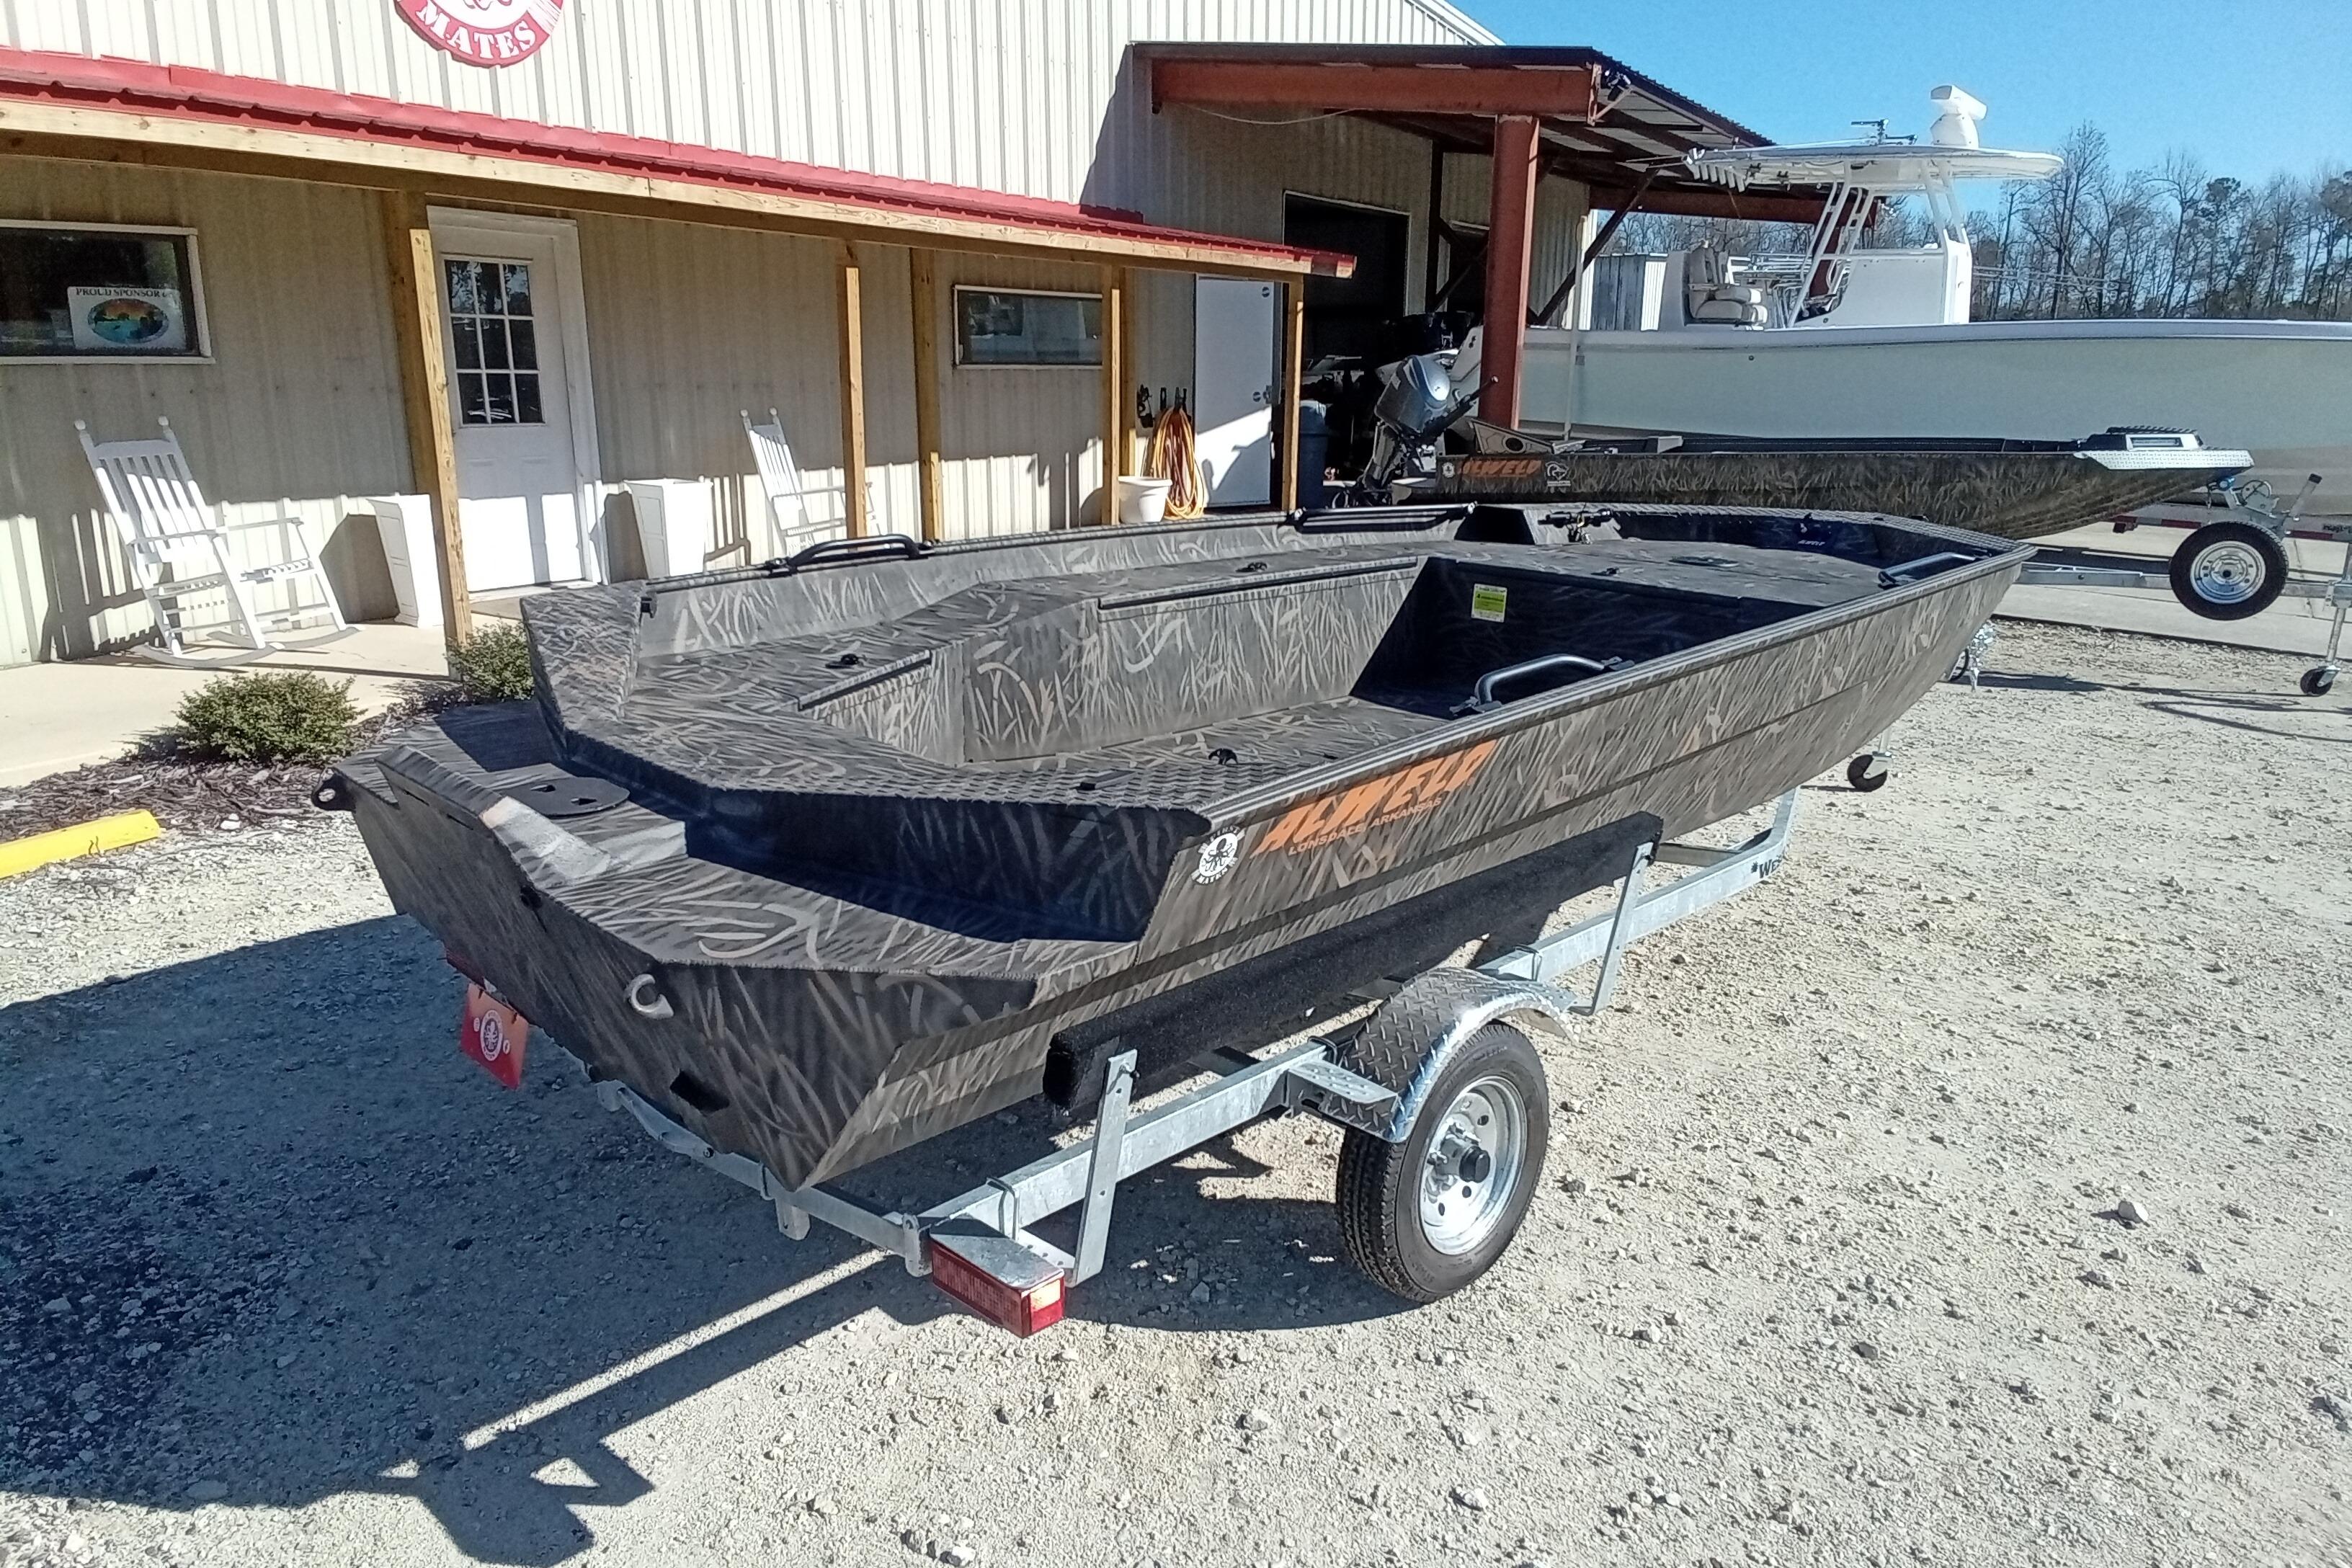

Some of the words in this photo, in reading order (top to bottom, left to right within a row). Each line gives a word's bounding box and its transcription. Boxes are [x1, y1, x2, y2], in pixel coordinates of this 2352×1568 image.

[414, 2, 536, 59] MATES
[76, 288, 111, 296] PROUD
[114, 288, 160, 298] SPONSOR
[1250, 739, 1498, 859] ALWELD
[1370, 797, 1442, 829] ARKANSAS
